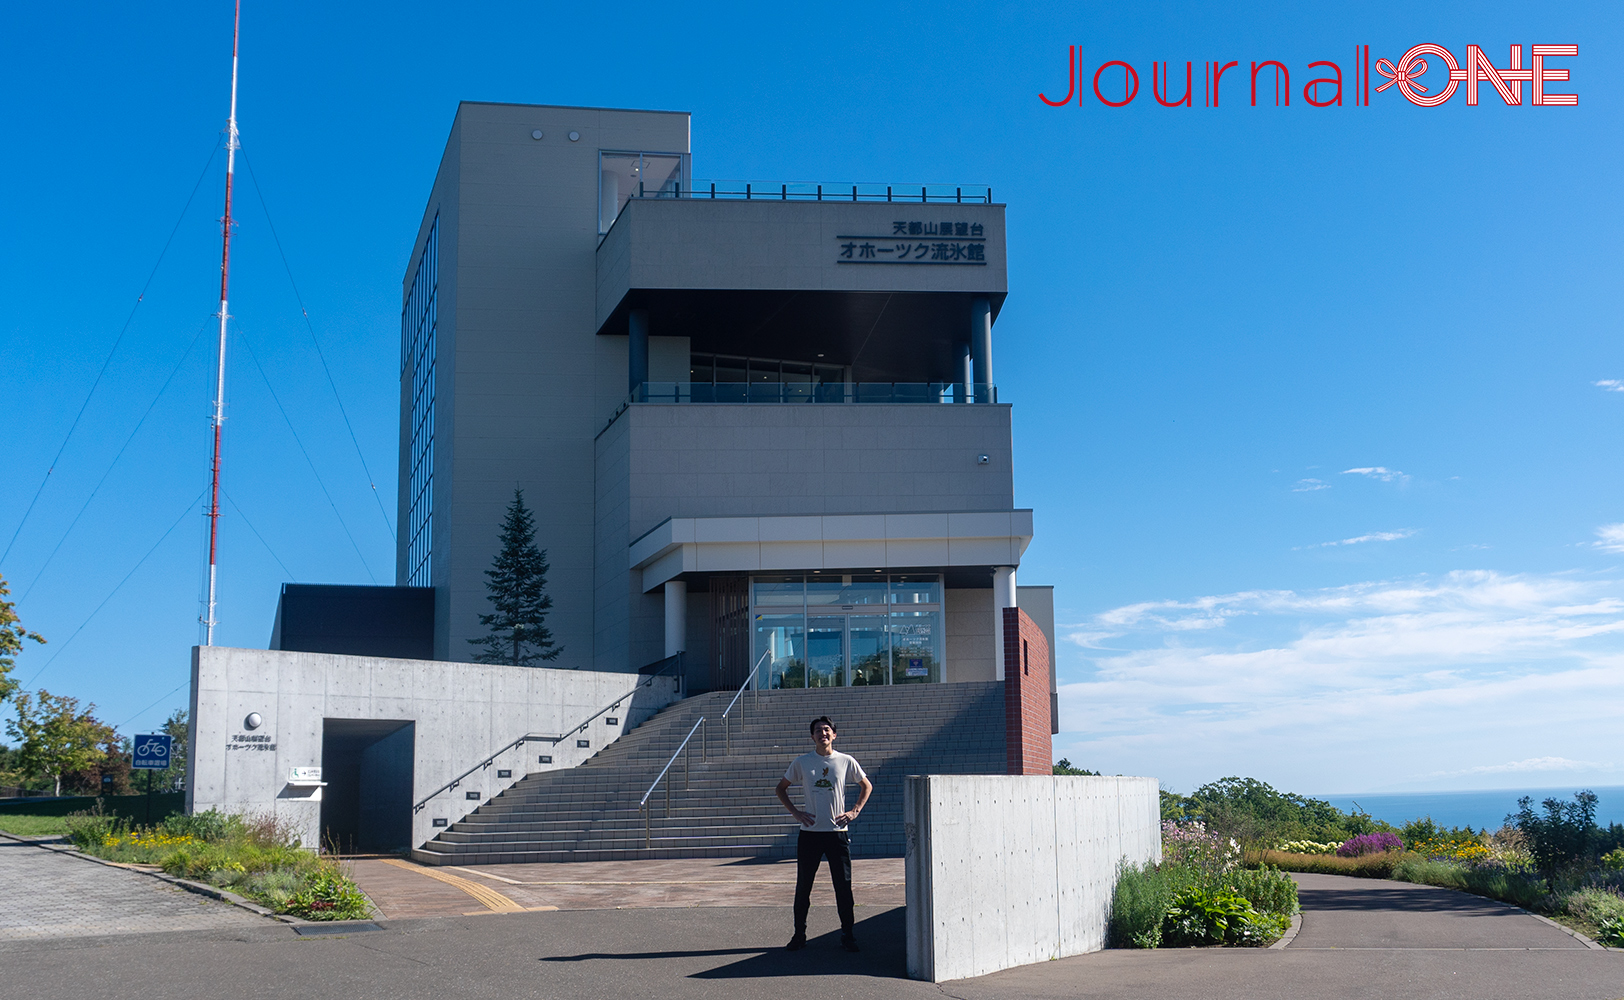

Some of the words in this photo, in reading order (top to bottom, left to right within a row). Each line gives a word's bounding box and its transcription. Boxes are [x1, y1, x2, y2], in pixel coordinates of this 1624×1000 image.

[893, 221, 984, 237] 天都山展望台
[840, 242, 985, 261] オホーツク流氷館
